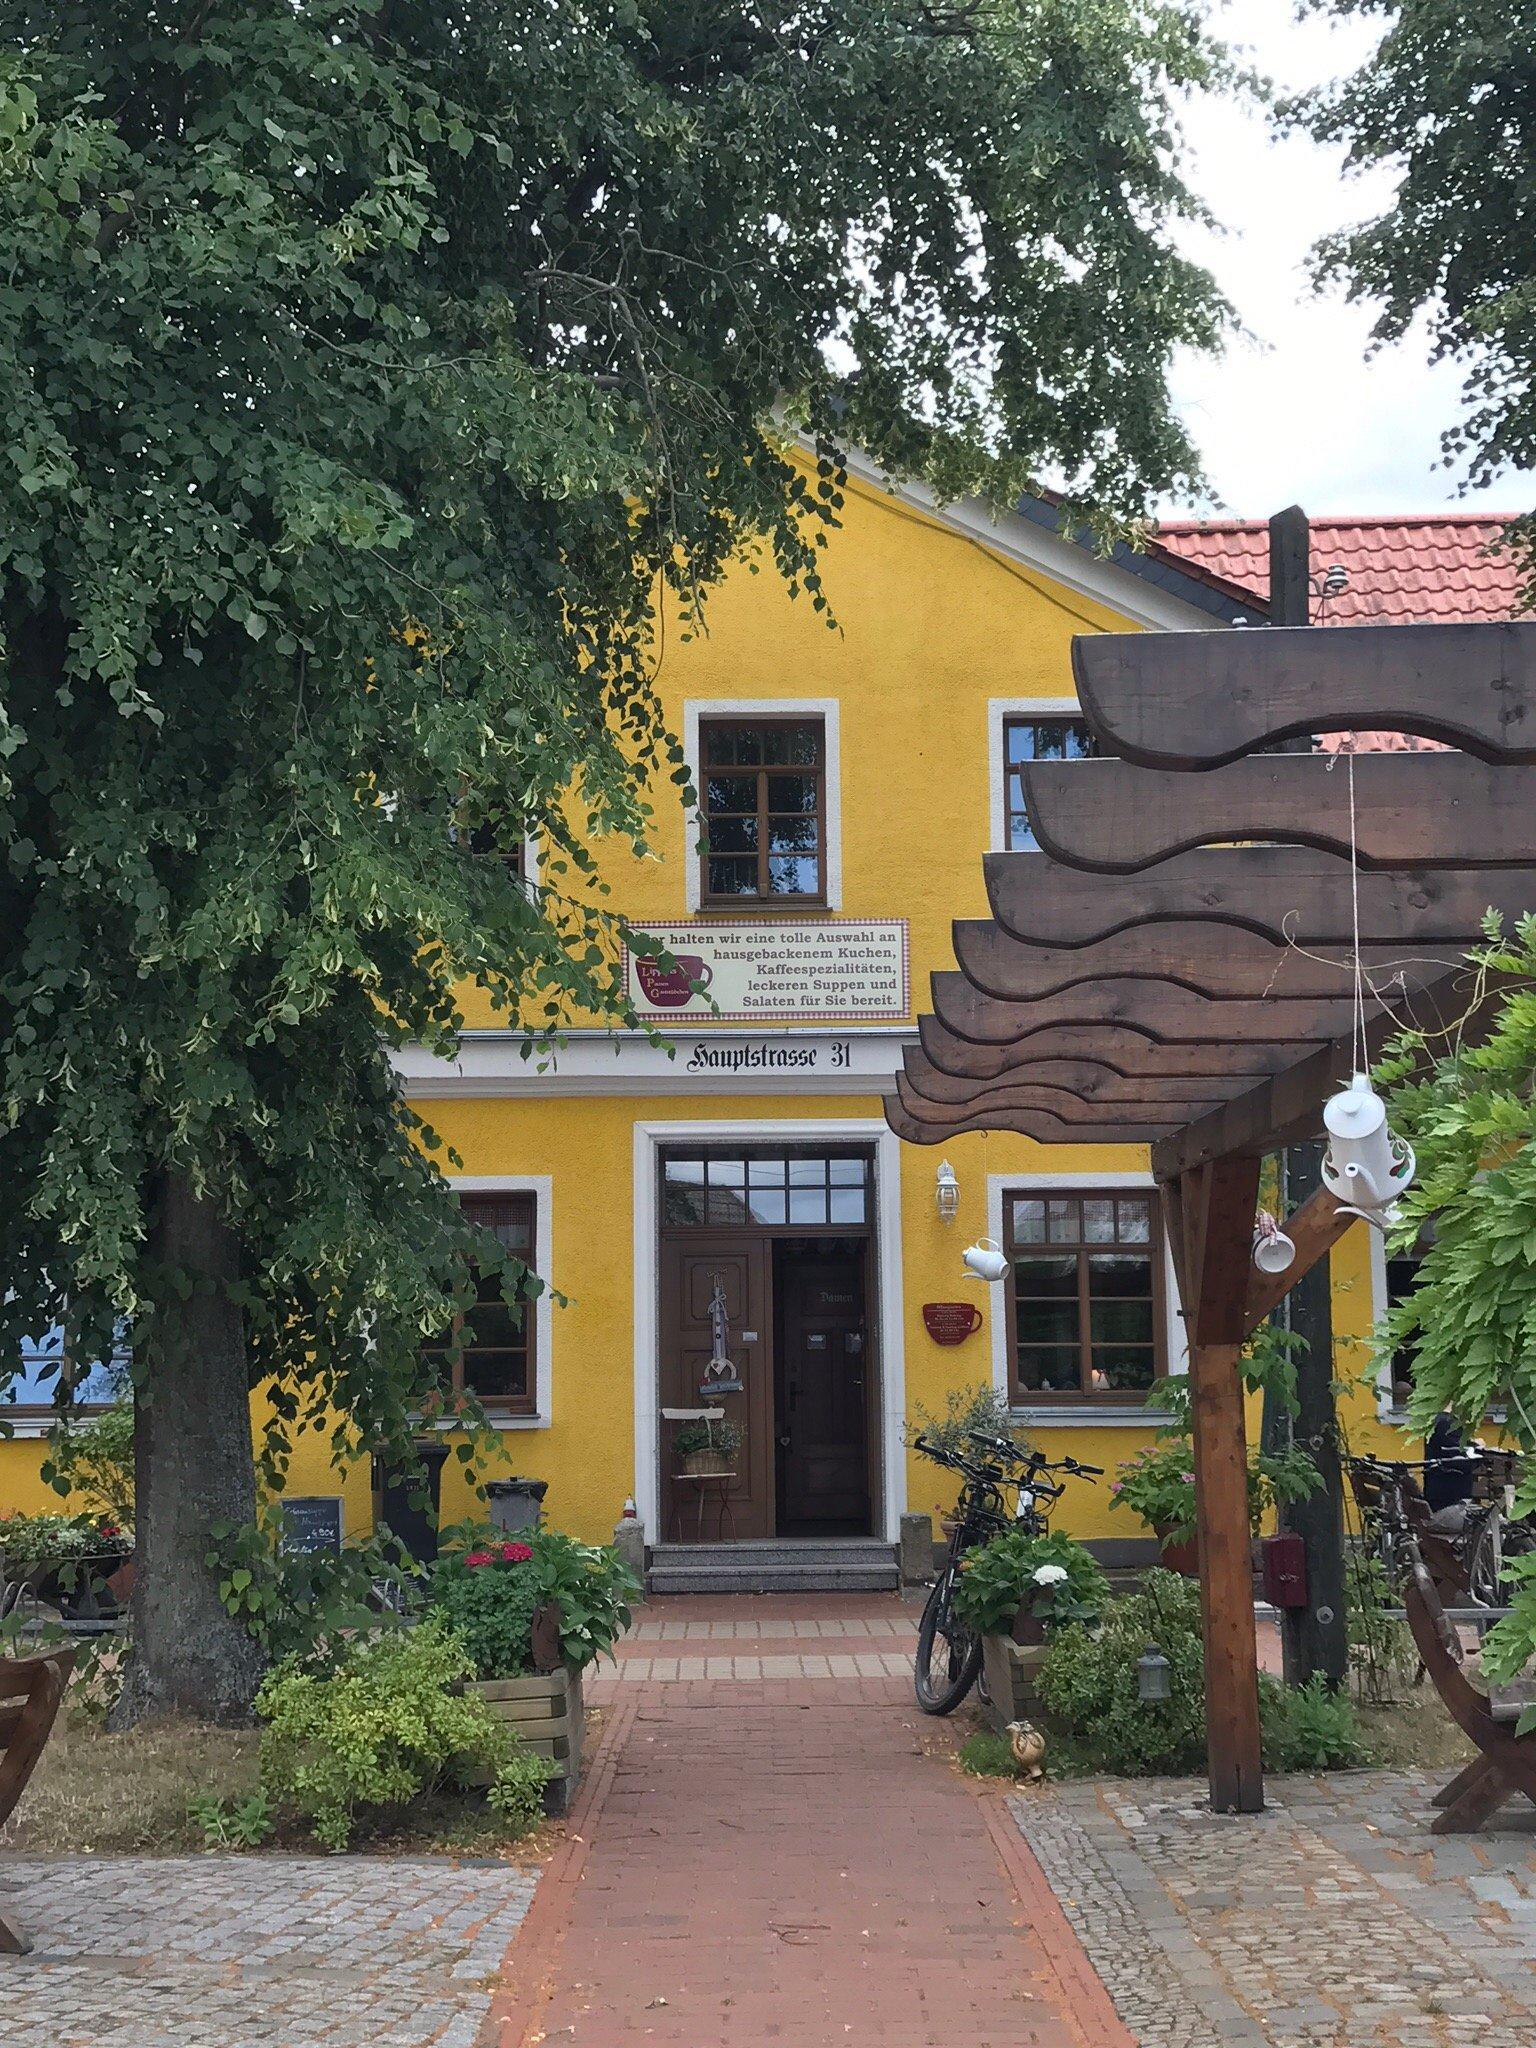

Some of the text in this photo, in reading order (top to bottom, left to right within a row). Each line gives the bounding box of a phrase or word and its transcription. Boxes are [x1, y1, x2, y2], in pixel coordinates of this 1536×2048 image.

[669, 933, 715, 945] halten
[718, 932, 742, 944] wir
[745, 932, 776, 944] eine
[779, 932, 812, 944] tolle
[816, 931, 875, 943] Auswahl
[878, 933, 897, 943] an
[712, 947, 898, 963] hausgebackenem Kuchen,
[756, 963, 898, 978] Kaffeespezialitäten,
[747, 978, 898, 993] leckeren Suppen und
[742, 994, 898, 1007] Salaten für Sie bereit.
[686, 1041, 852, 1073] Hauptstrasse 31
